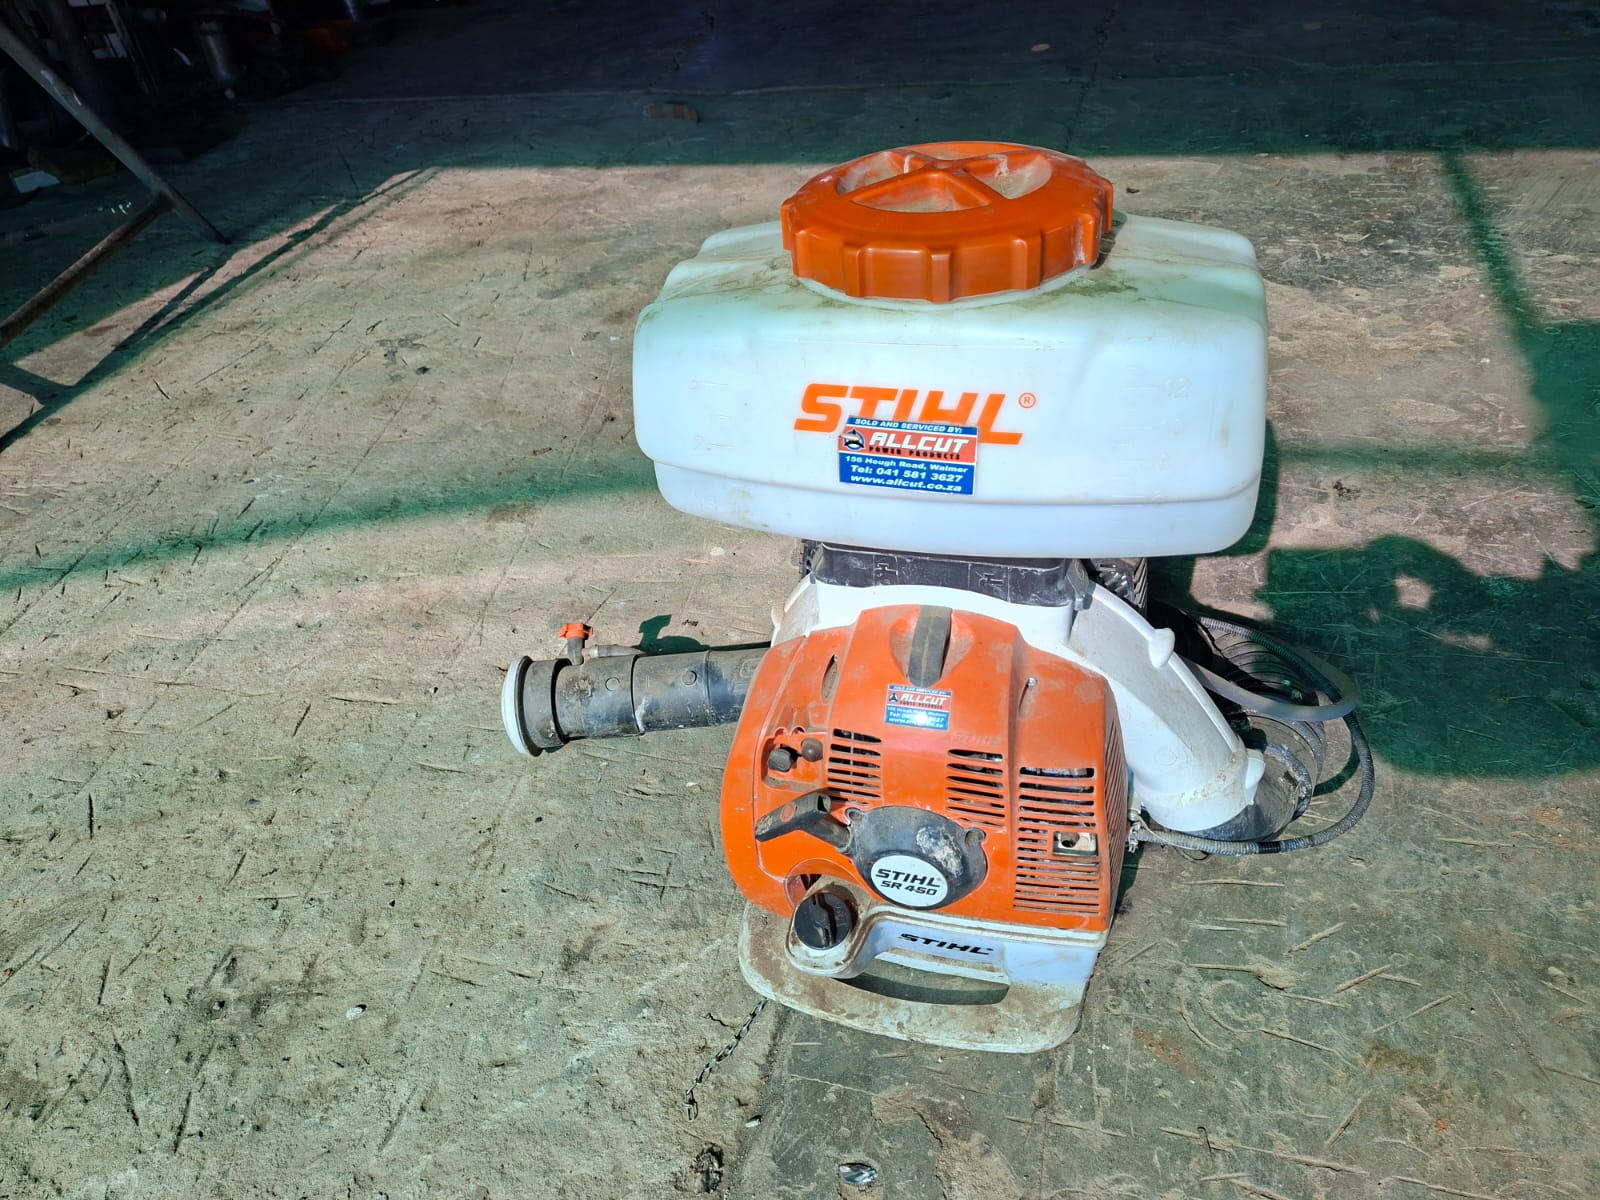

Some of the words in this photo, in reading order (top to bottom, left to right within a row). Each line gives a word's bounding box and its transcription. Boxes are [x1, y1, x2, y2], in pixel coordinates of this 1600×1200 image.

[793, 383, 1024, 446] STIHL
[855, 418, 878, 426] SOLD
[880, 421, 899, 429] AND
[900, 422, 945, 432] SERVICED
[869, 431, 970, 454] ALLCUT
[869, 446, 901, 455] POWER
[909, 449, 960, 460] PRODUCTS
[850, 465, 873, 474] Tel:
[876, 467, 899, 477] 041
[903, 470, 926, 479] 581
[930, 472, 963, 482] 3627
[899, 461, 927, 470] Road,
[929, 463, 969, 473] Walmer
[850, 475, 962, 492] www.allcut.co.za
[900, 693, 947, 706] ALLCUT
[875, 868, 941, 888] STIHL
[880, 880, 902, 890] SR
[904, 885, 938, 896] 450
[898, 933, 991, 955] STIHL
